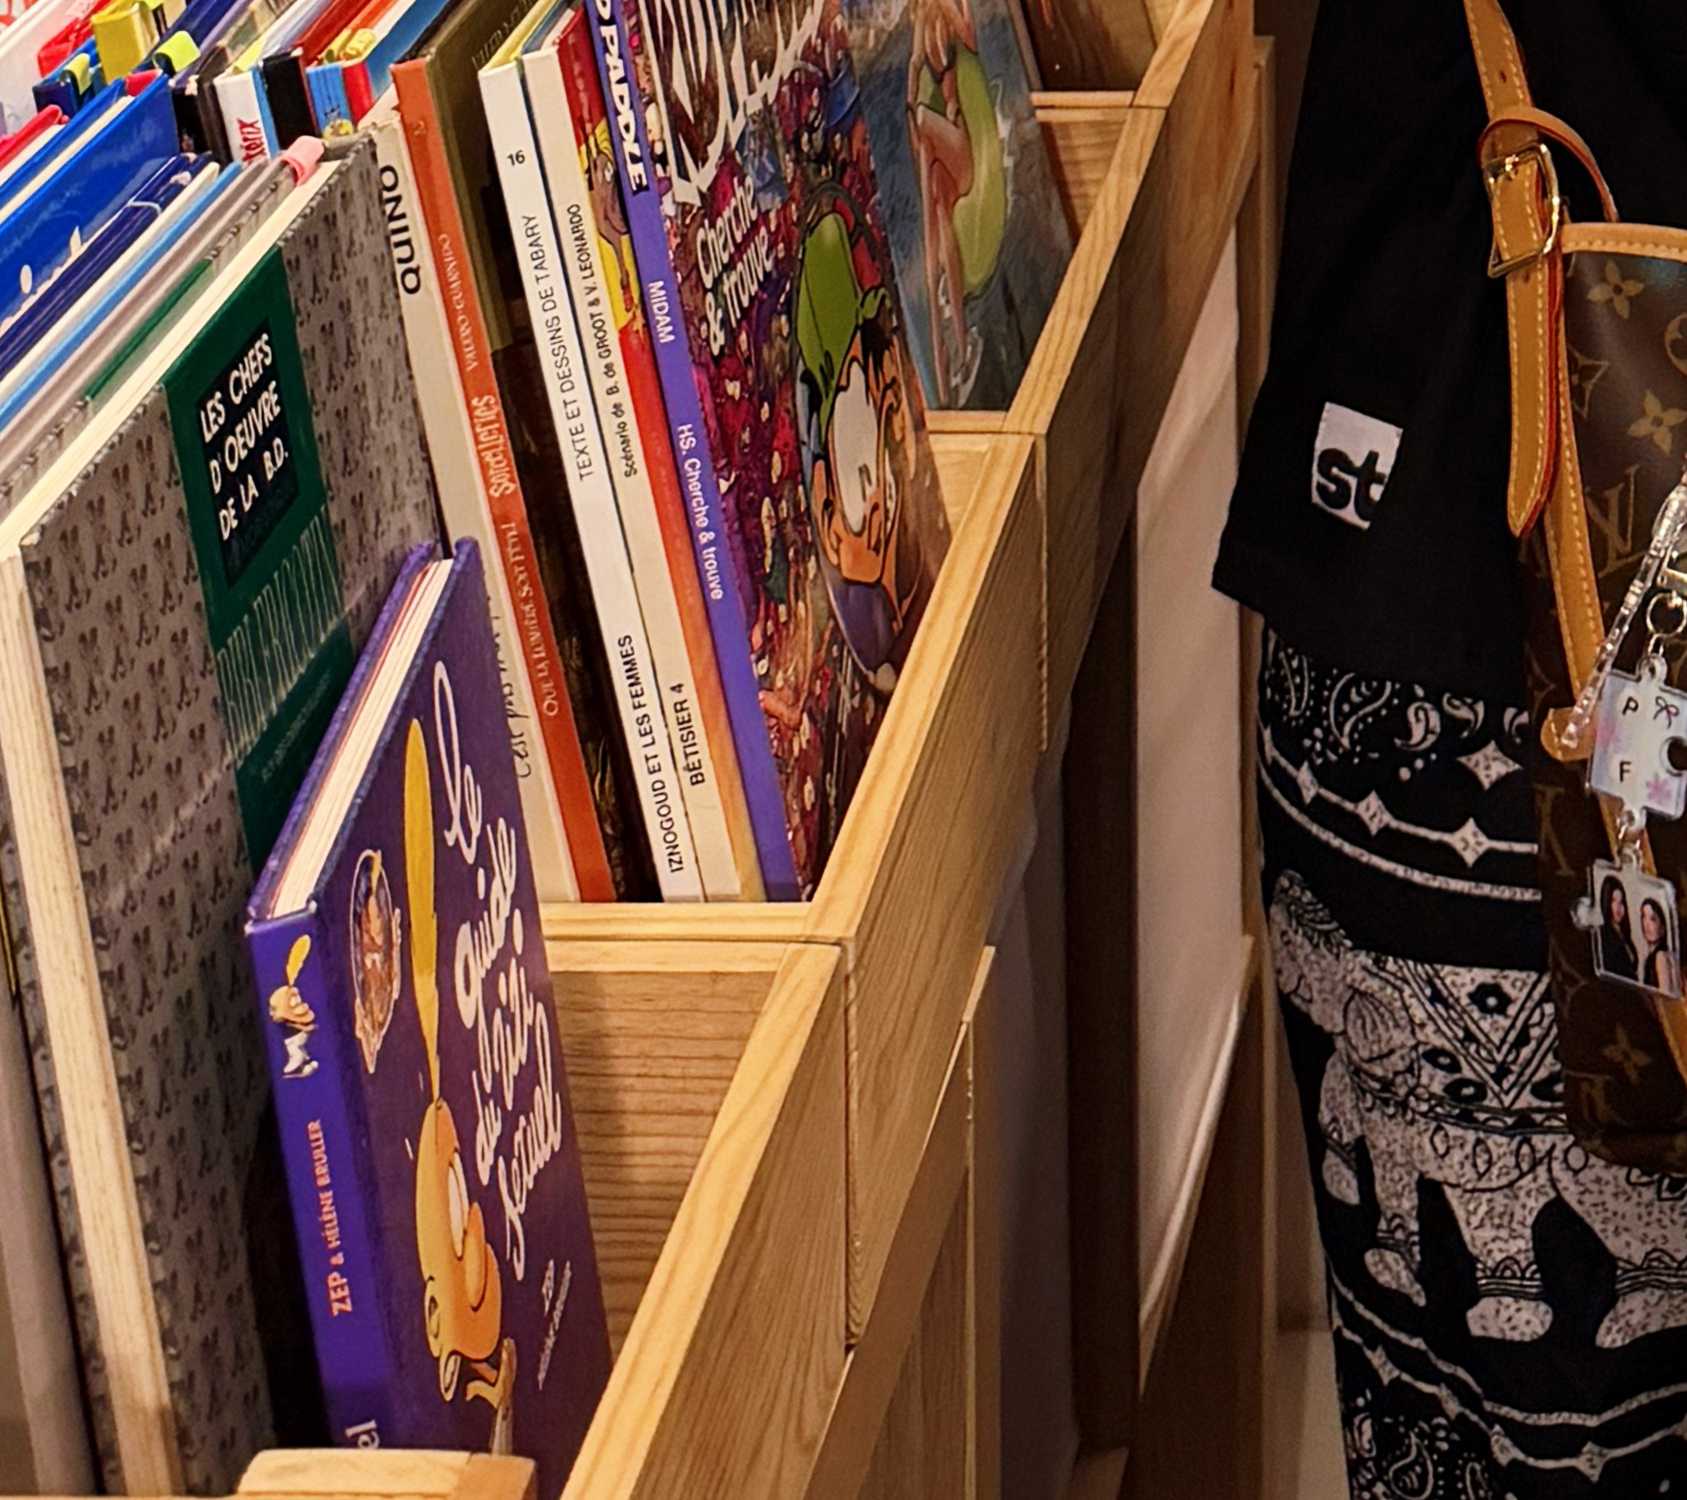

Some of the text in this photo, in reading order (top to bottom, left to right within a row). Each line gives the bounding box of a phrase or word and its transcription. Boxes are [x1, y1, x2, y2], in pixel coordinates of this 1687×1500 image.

[378, 163, 422, 296] QUINO
[567, 203, 594, 278] LEONARDO
[692, 161, 761, 298] Cherche
[701, 217, 776, 363] & trouve
[507, 149, 594, 481] TEXTE ET DESSINS DE TABARY 16
[605, 22, 650, 194] PADDLE
[647, 280, 673, 344] MIDAM
[682, 457, 709, 529] Cherche
[702, 544, 724, 600] trouve
[200, 332, 273, 443] LES CHEFS
[612, 421, 638, 478] Scénario
[218, 436, 290, 543] DE LA B.D.
[1315, 445, 1387, 525] st
[433, 660, 483, 865] le
[619, 634, 685, 873] IZNOGOUD ET LES FEMMES
[1618, 759, 1632, 783] F
[454, 816, 516, 1094] guide
[472, 907, 535, 1186] du zizi
[305, 1119, 330, 1188] BRULLER
[498, 1001, 562, 1282] sexuel
[326, 1272, 352, 1317] ZEP
